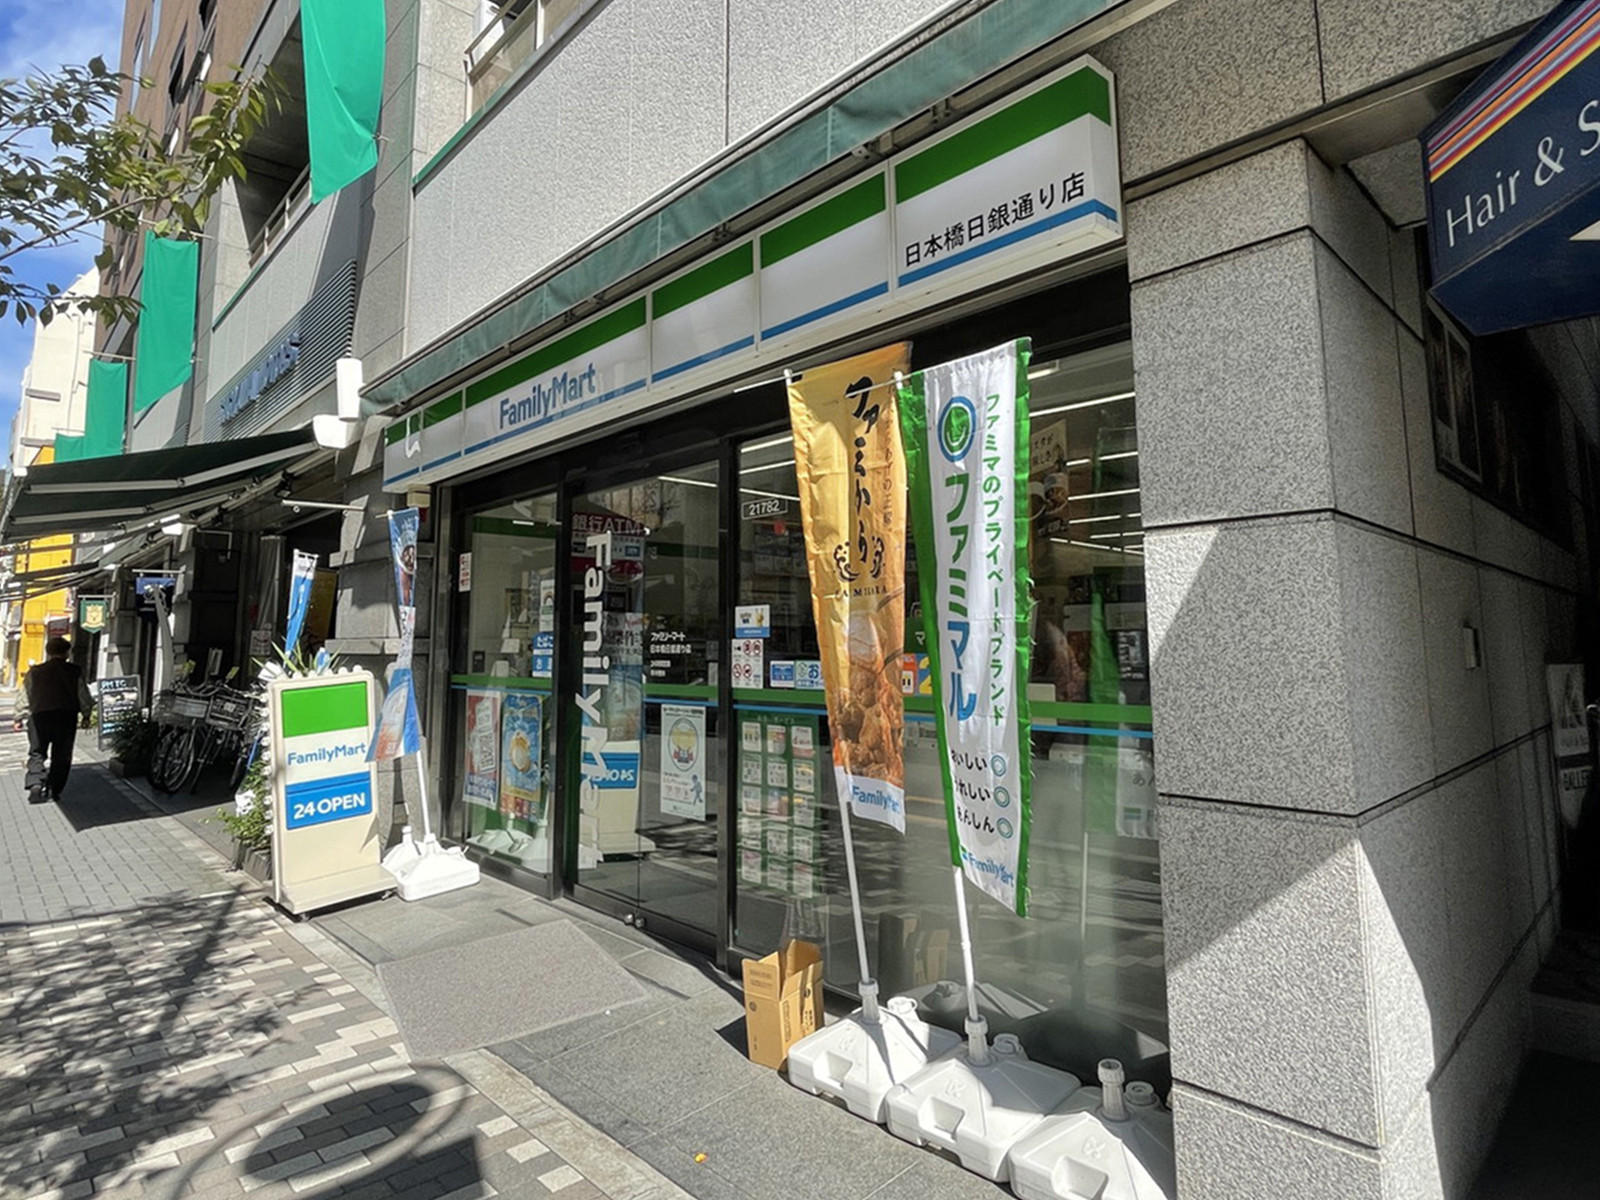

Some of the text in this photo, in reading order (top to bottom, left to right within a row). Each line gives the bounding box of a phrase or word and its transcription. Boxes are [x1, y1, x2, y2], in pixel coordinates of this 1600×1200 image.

[905, 170, 1085, 267] 日本橋日銀通り店
[1446, 168, 1521, 247] Hair
[1534, 136, 1565, 188] &
[499, 362, 597, 430] FamilyMart
[572, 513, 641, 535] 銀行ATM
[748, 500, 780, 516] 21782
[981, 393, 1006, 726] ファミマのプライベートブランド
[945, 473, 977, 721] ファミマル
[575, 530, 613, 869] FamilyMart
[287, 741, 367, 767] FamilyMart
[317, 792, 366, 815] OPEN
[954, 775, 991, 802] れしい
